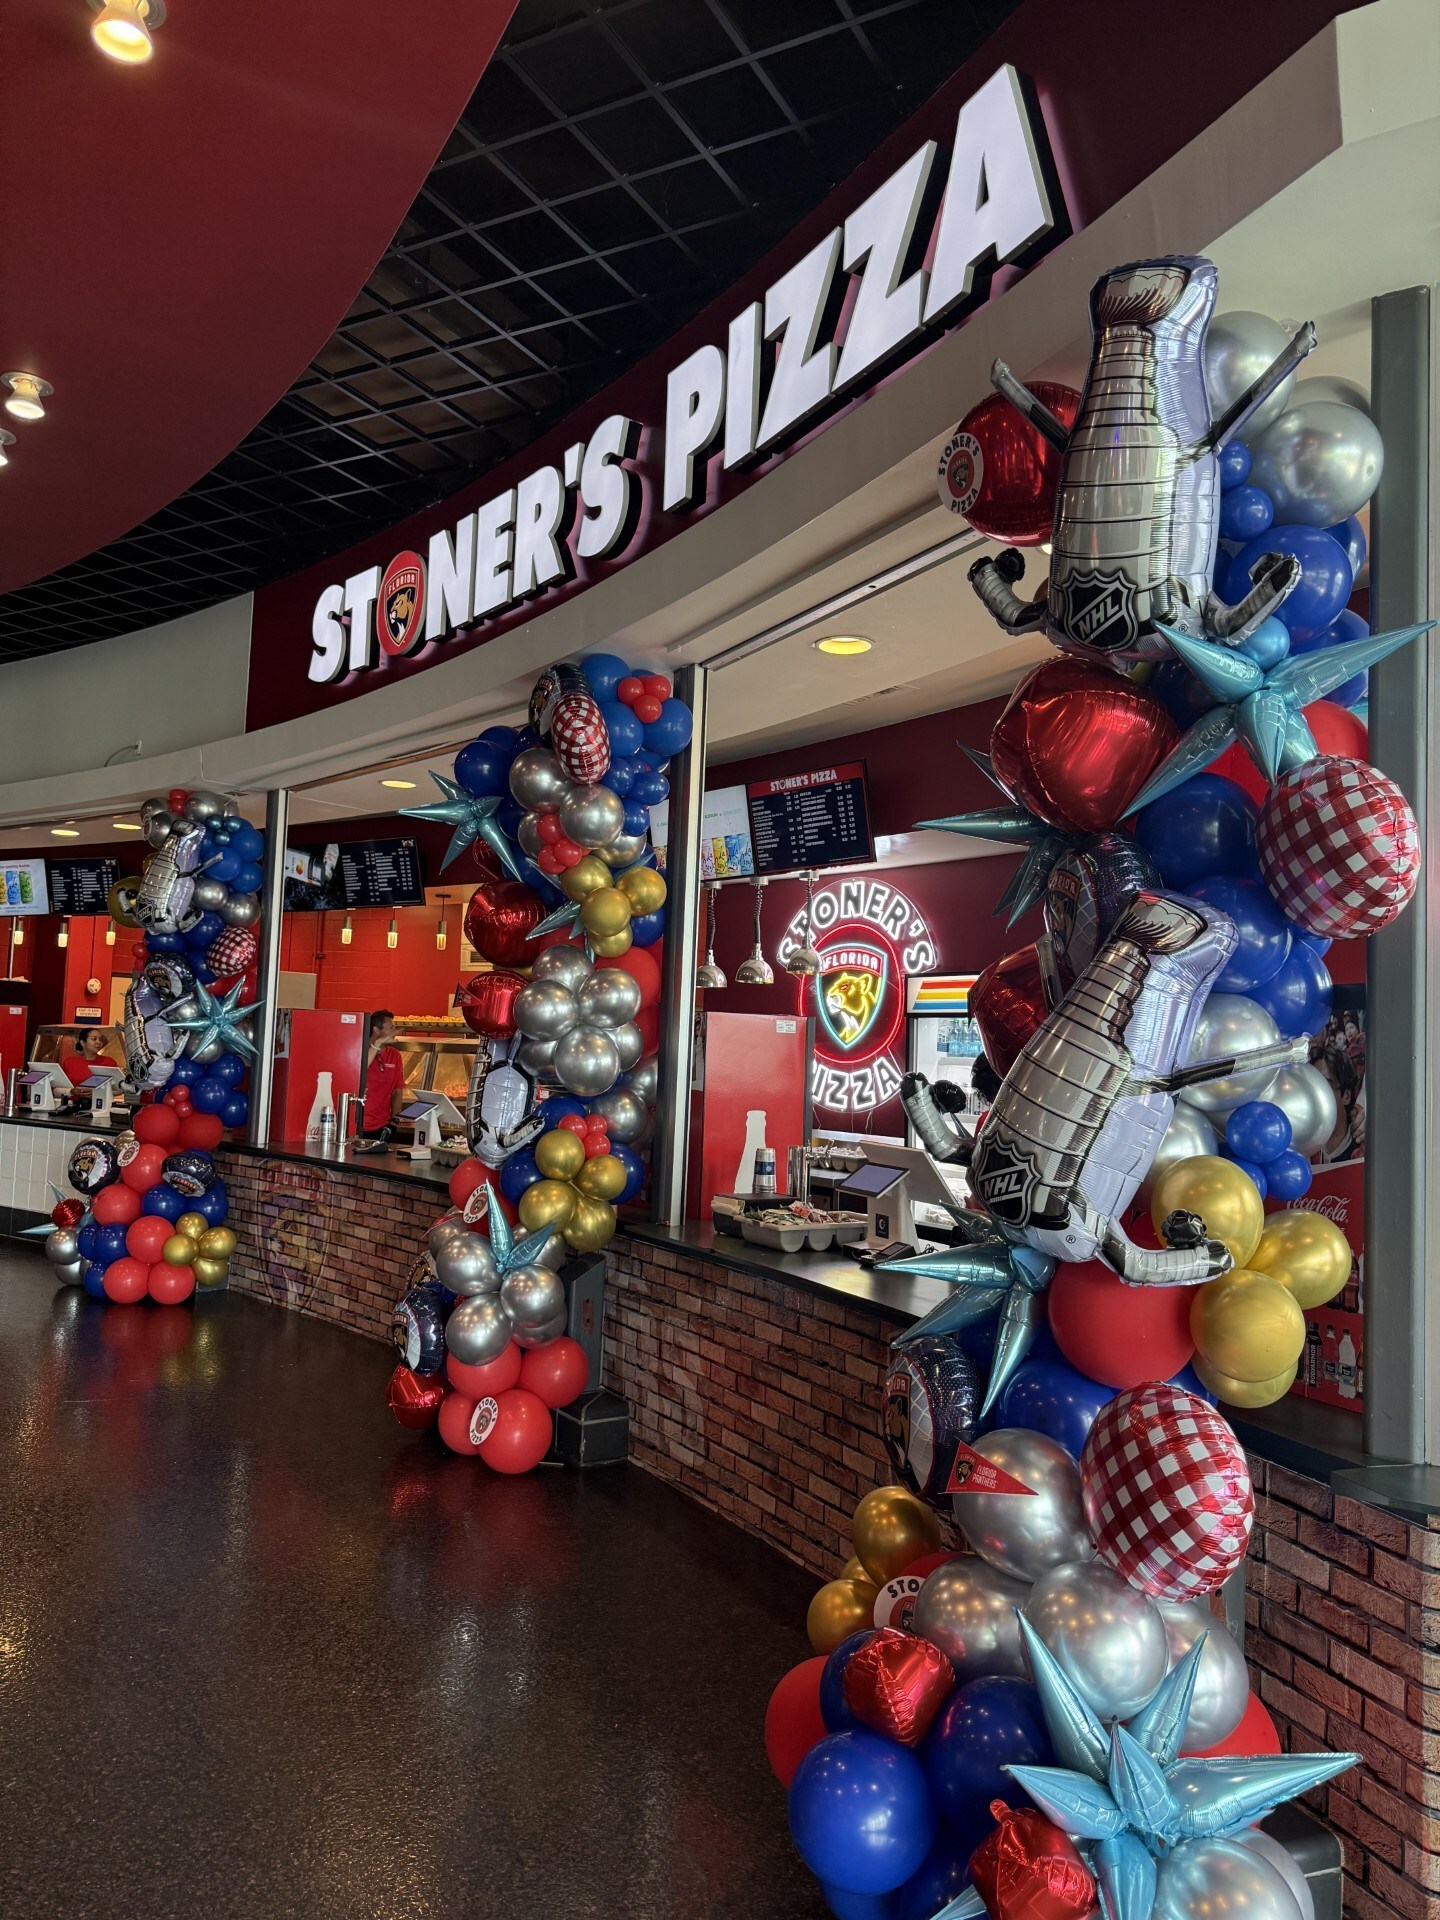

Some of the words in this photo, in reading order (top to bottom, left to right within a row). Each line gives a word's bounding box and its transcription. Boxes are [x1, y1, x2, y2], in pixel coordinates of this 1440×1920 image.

[663, 63, 1054, 512] PIZZA
[938, 435, 979, 476] STONER'S
[950, 487, 978, 512] PIZZA
[388, 573, 415, 595] FLORIDA
[1077, 594, 1119, 639] NHL
[810, 769, 837, 784] PIZZA
[779, 881, 934, 974] STONER'S
[824, 952, 879, 971] FLORIDA
[812, 1056, 903, 1110] IZZA
[984, 1172, 1022, 1199] NHL
[972, 1473, 996, 1489] PANTHERS
[977, 1465, 997, 1479] FLORIDA
